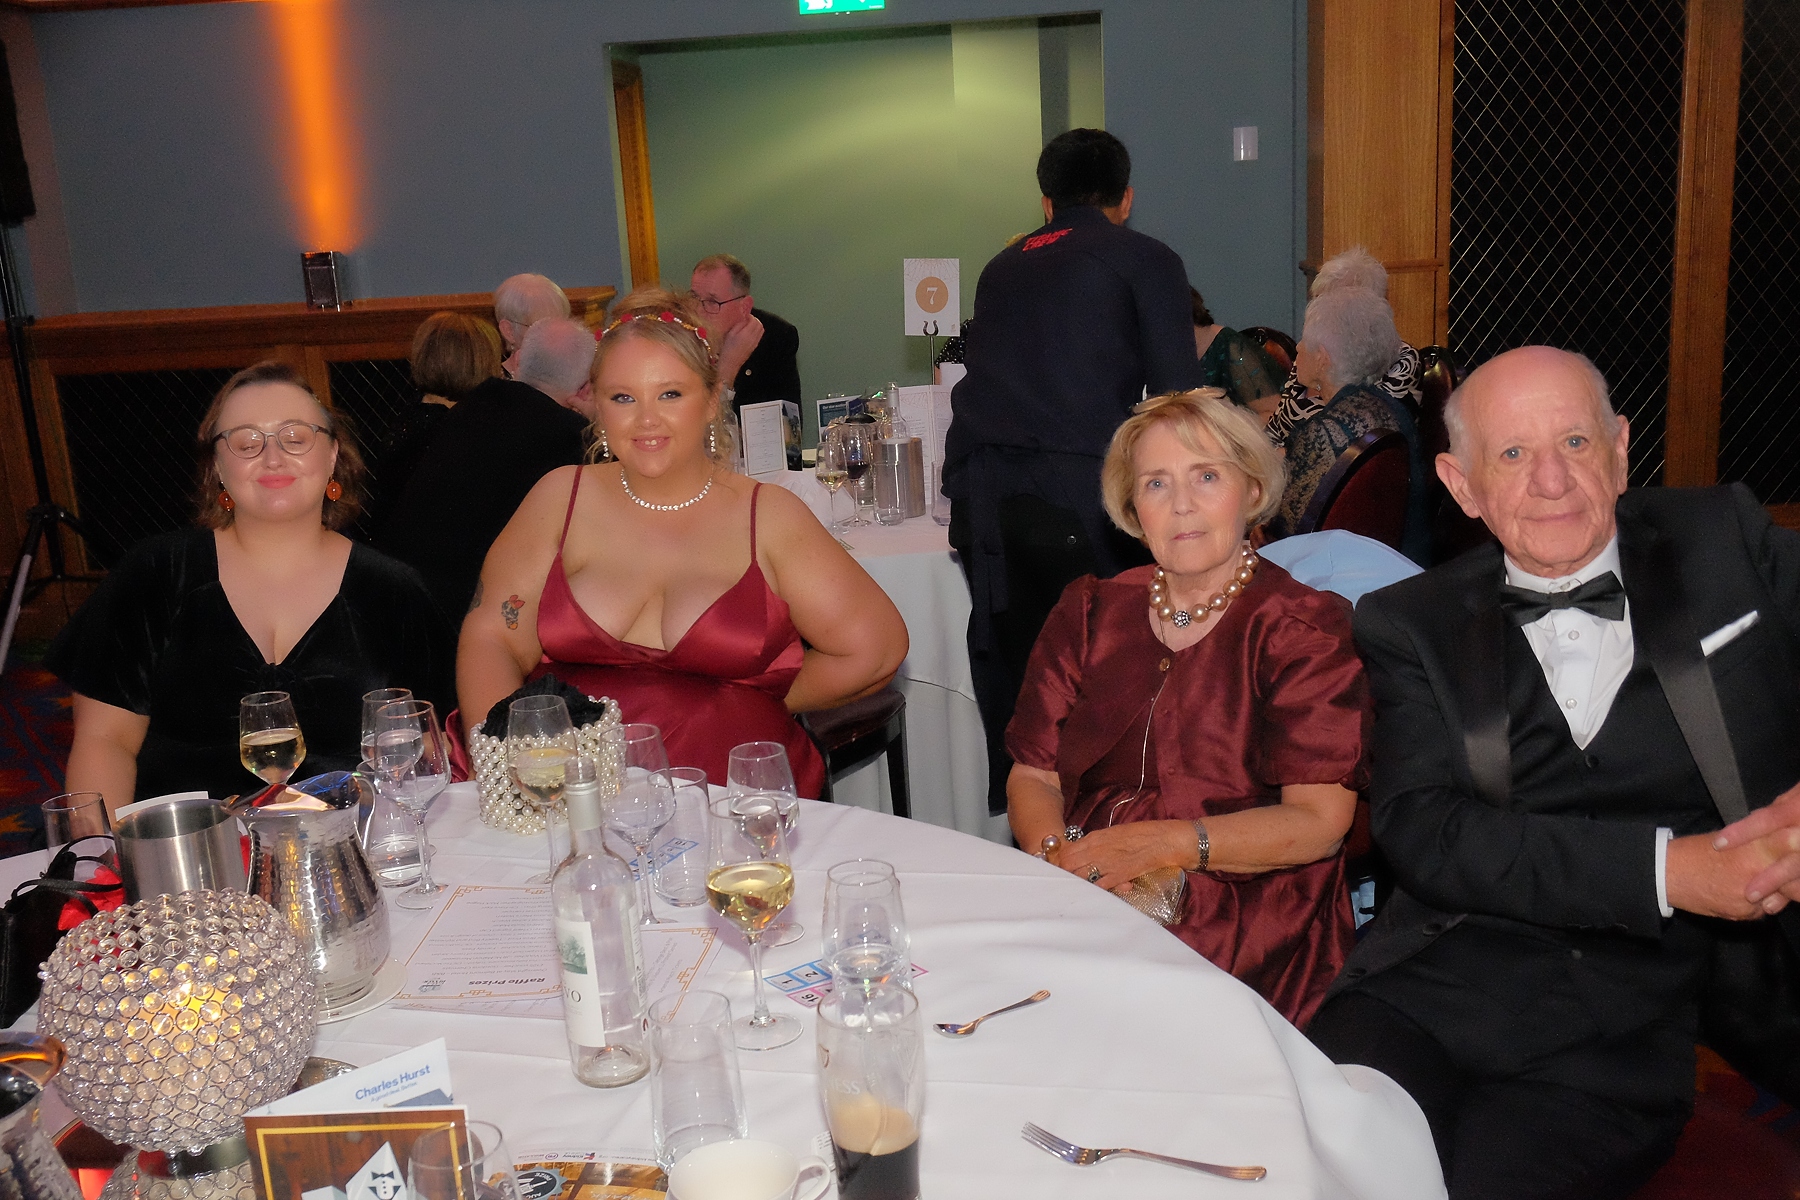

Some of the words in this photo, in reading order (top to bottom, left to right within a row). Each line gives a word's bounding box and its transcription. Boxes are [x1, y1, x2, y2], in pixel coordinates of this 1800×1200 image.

[926, 286, 939, 306] 7
[804, 970, 819, 978] 2
[507, 977, 546, 985] Raffle
[563, 985, 582, 1003] VO
[801, 992, 819, 1003] 16
[355, 1078, 399, 1100] Charles
[399, 1064, 431, 1083] Hurst
[534, 1172, 553, 1182] PRIZE
